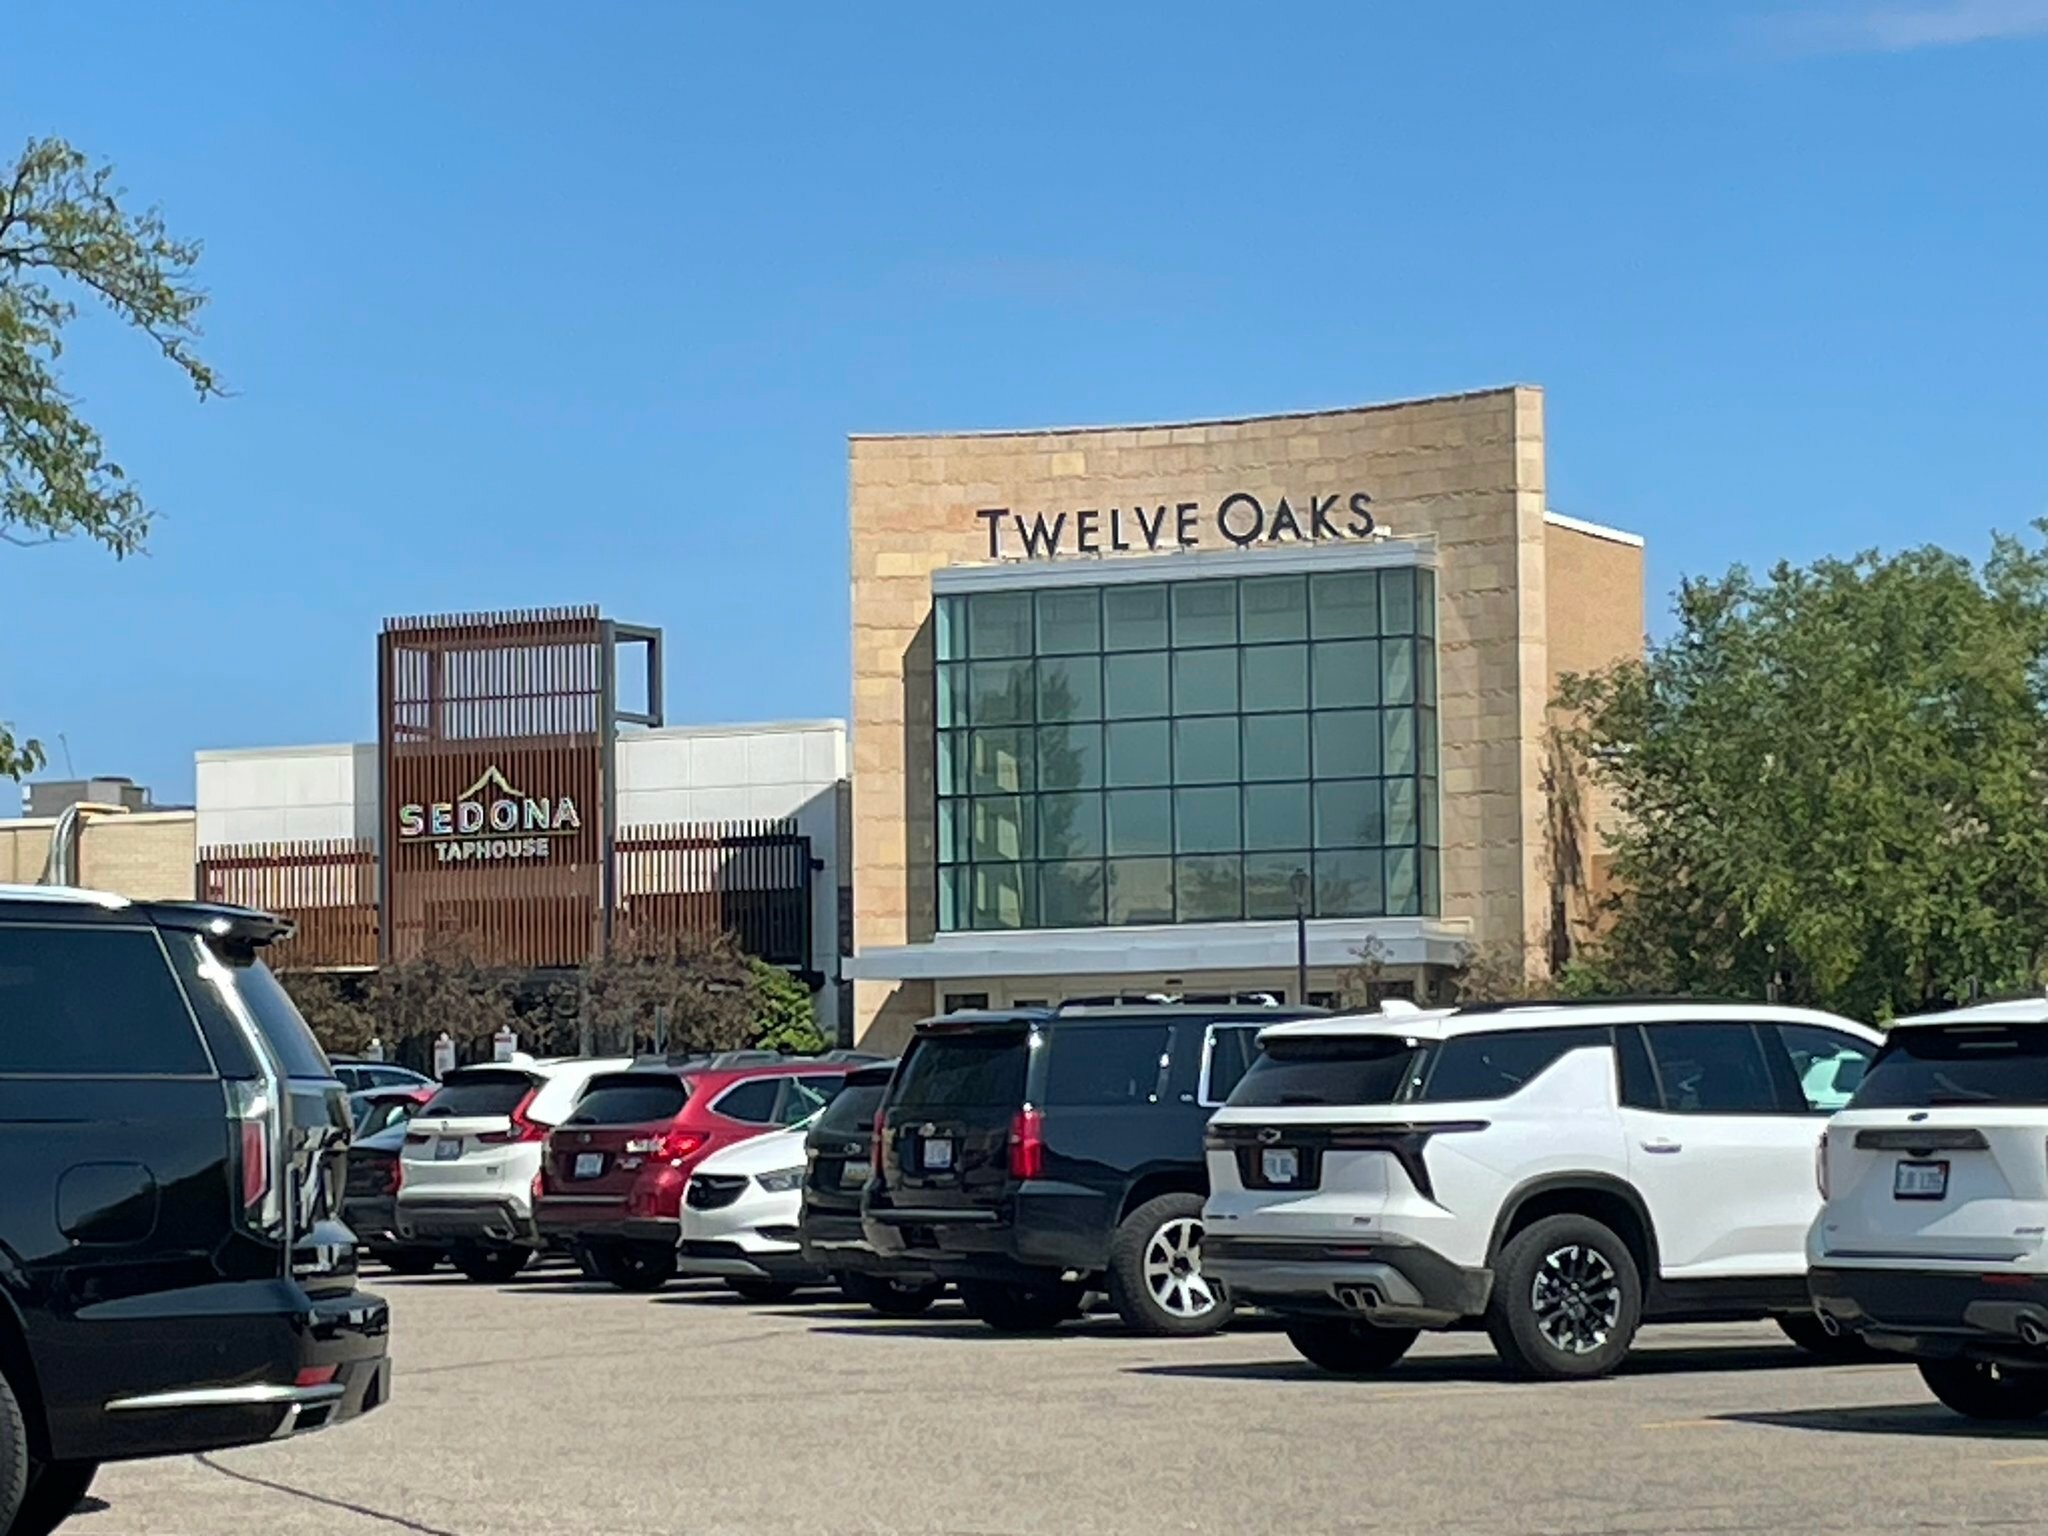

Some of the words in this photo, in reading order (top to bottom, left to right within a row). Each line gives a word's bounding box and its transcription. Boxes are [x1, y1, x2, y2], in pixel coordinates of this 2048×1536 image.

[977, 503, 1199, 558] TWELVE
[1216, 492, 1375, 546] OAKS
[400, 797, 582, 836] SEDONA
[435, 838, 549, 862] TAPHOUSE
